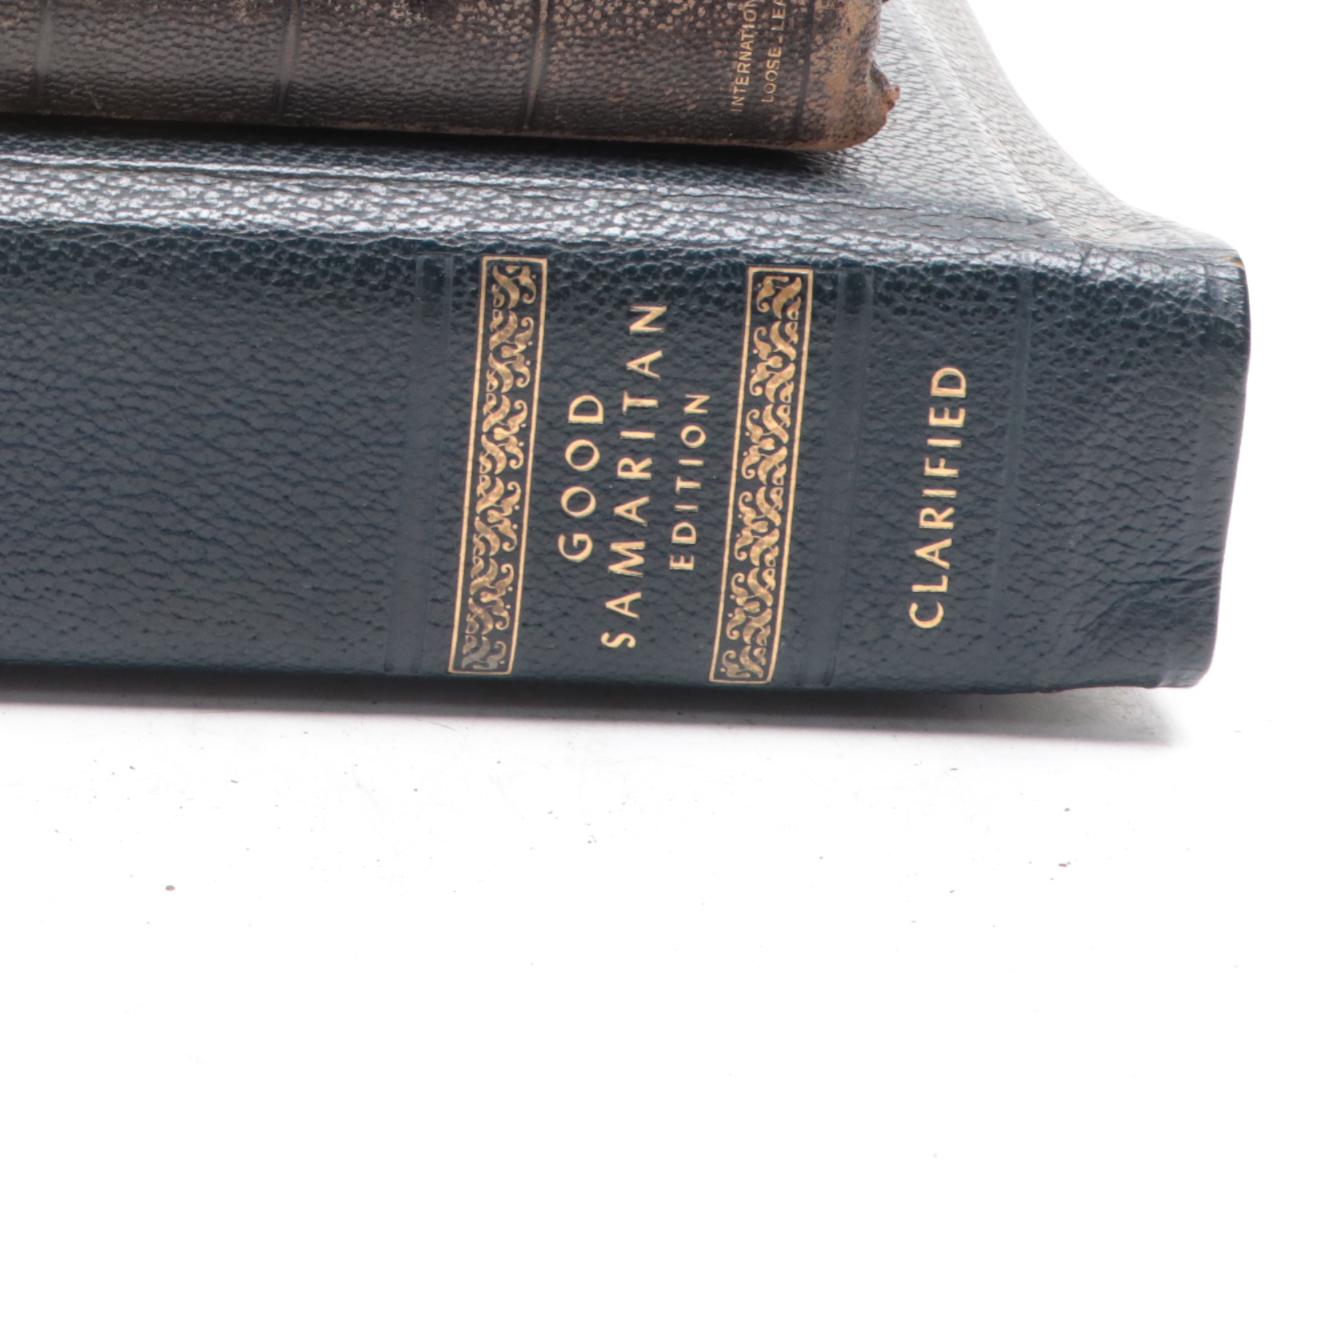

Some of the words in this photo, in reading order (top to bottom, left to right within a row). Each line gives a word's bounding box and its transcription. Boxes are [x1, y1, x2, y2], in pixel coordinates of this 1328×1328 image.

[557, 393, 604, 563] GOOD
[600, 302, 668, 649] SAMARITAN
[669, 392, 711, 571] EDITION
[908, 365, 968, 630] CLARIFIED
